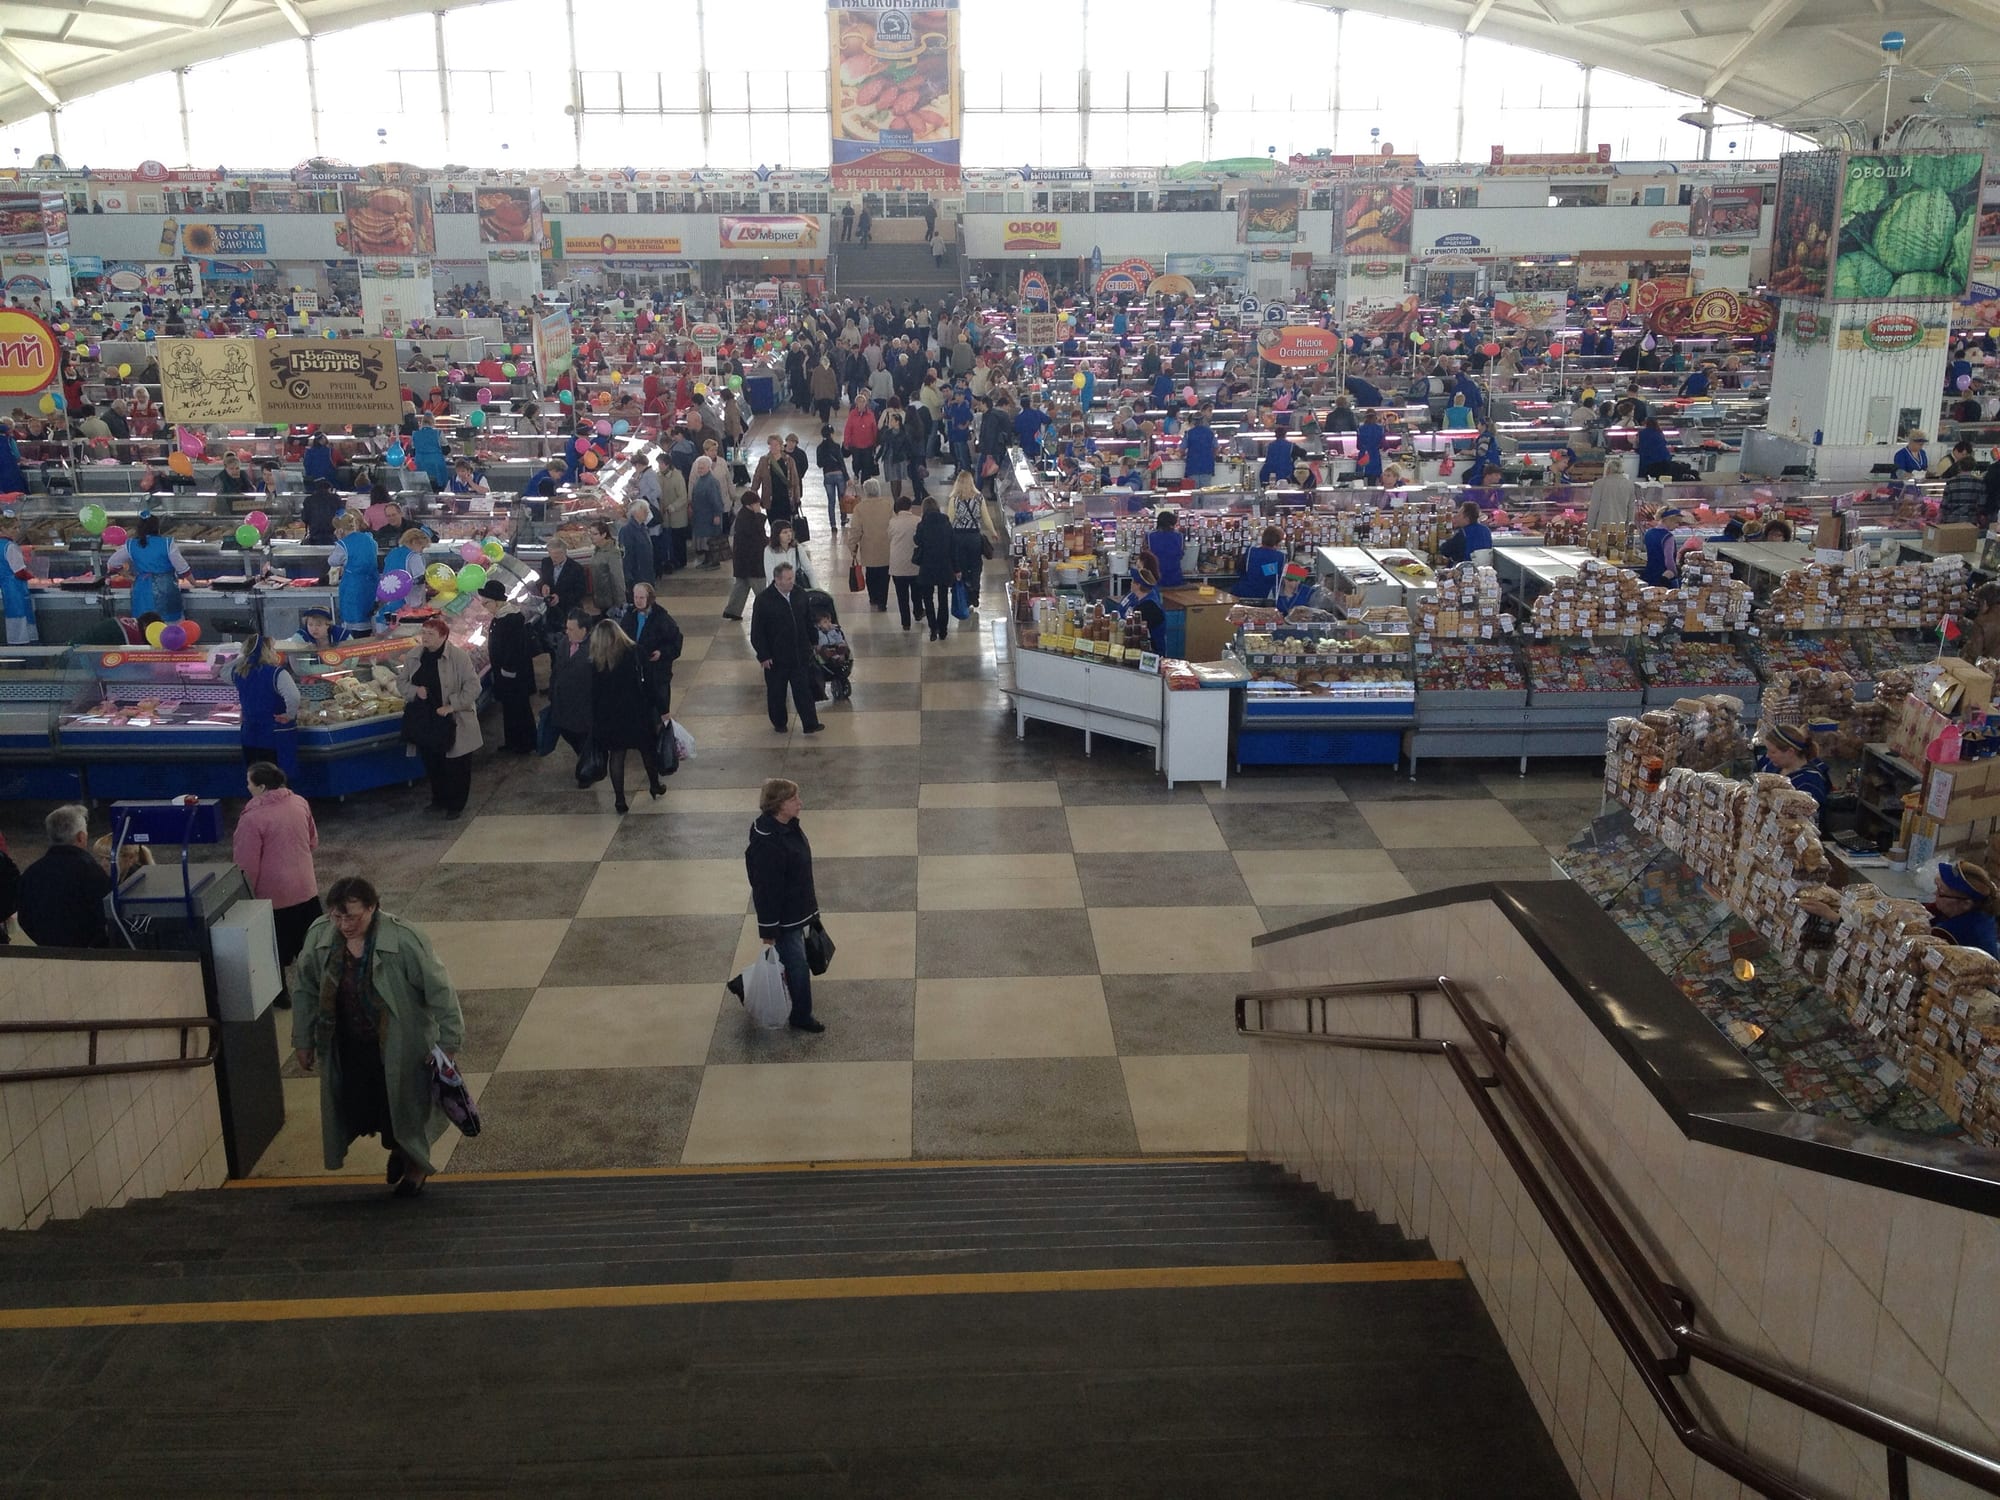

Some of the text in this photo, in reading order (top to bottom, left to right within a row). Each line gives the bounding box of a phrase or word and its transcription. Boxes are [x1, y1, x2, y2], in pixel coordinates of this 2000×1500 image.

[311, 173, 357, 181] КОНФЕТЫ
[842, 167, 945, 177] ФИРМЕННЫЙ МАГАЗИН
[1030, 172, 1089, 180] БЫТОВАЯ ТЕХНИКА
[1110, 171, 1157, 179] КОНФЕТЫ
[1851, 165, 1913, 180] ОВОЩИ
[1008, 222, 1058, 234] ОБОИ
[759, 228, 800, 242] маркет
[1430, 247, 1458, 255] ЛИЧНОГО
[1460, 247, 1491, 255] ПОДВОРЬЯ
[305, 349, 360, 361] Братья
[291, 352, 361, 371] Грилль
[220, 395, 240, 405] как
[267, 402, 394, 410] БРОЙЛЕРНАЯ ПТИЦЕФАБРИКА
